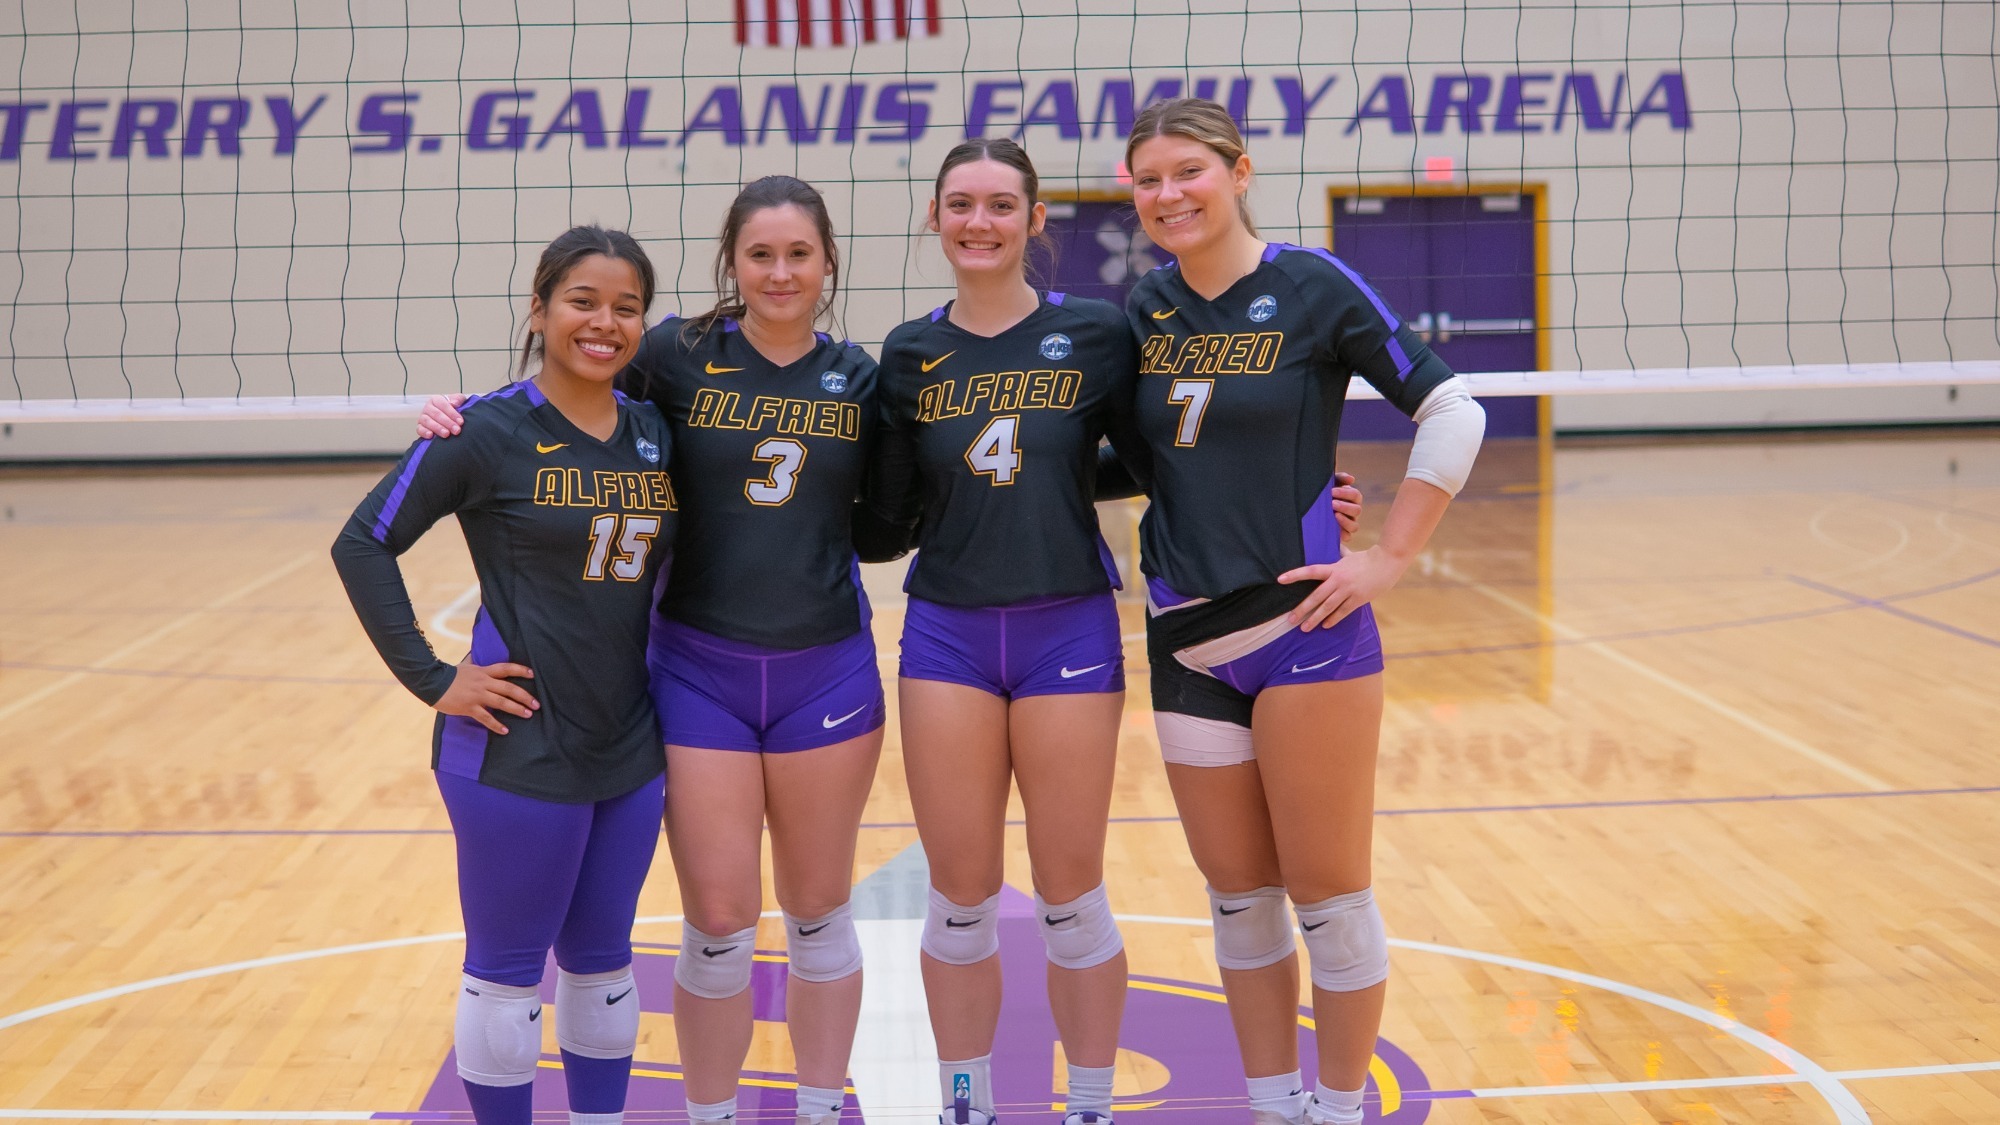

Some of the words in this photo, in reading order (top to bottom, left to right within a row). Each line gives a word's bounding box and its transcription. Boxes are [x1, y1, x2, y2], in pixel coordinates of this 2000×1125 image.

[0, 95, 328, 162] TERRY
[351, 92, 441, 154] S.
[465, 80, 937, 152] GALANIS
[1345, 70, 1694, 136] ARENA
[1139, 331, 1283, 374] ALFRED
[688, 388, 861, 441] ALFRED
[915, 370, 1082, 422] ALFRED
[1167, 378, 1215, 447] 7
[744, 437, 808, 507] 3
[963, 414, 1022, 486] 4
[583, 513, 661, 582] 15
